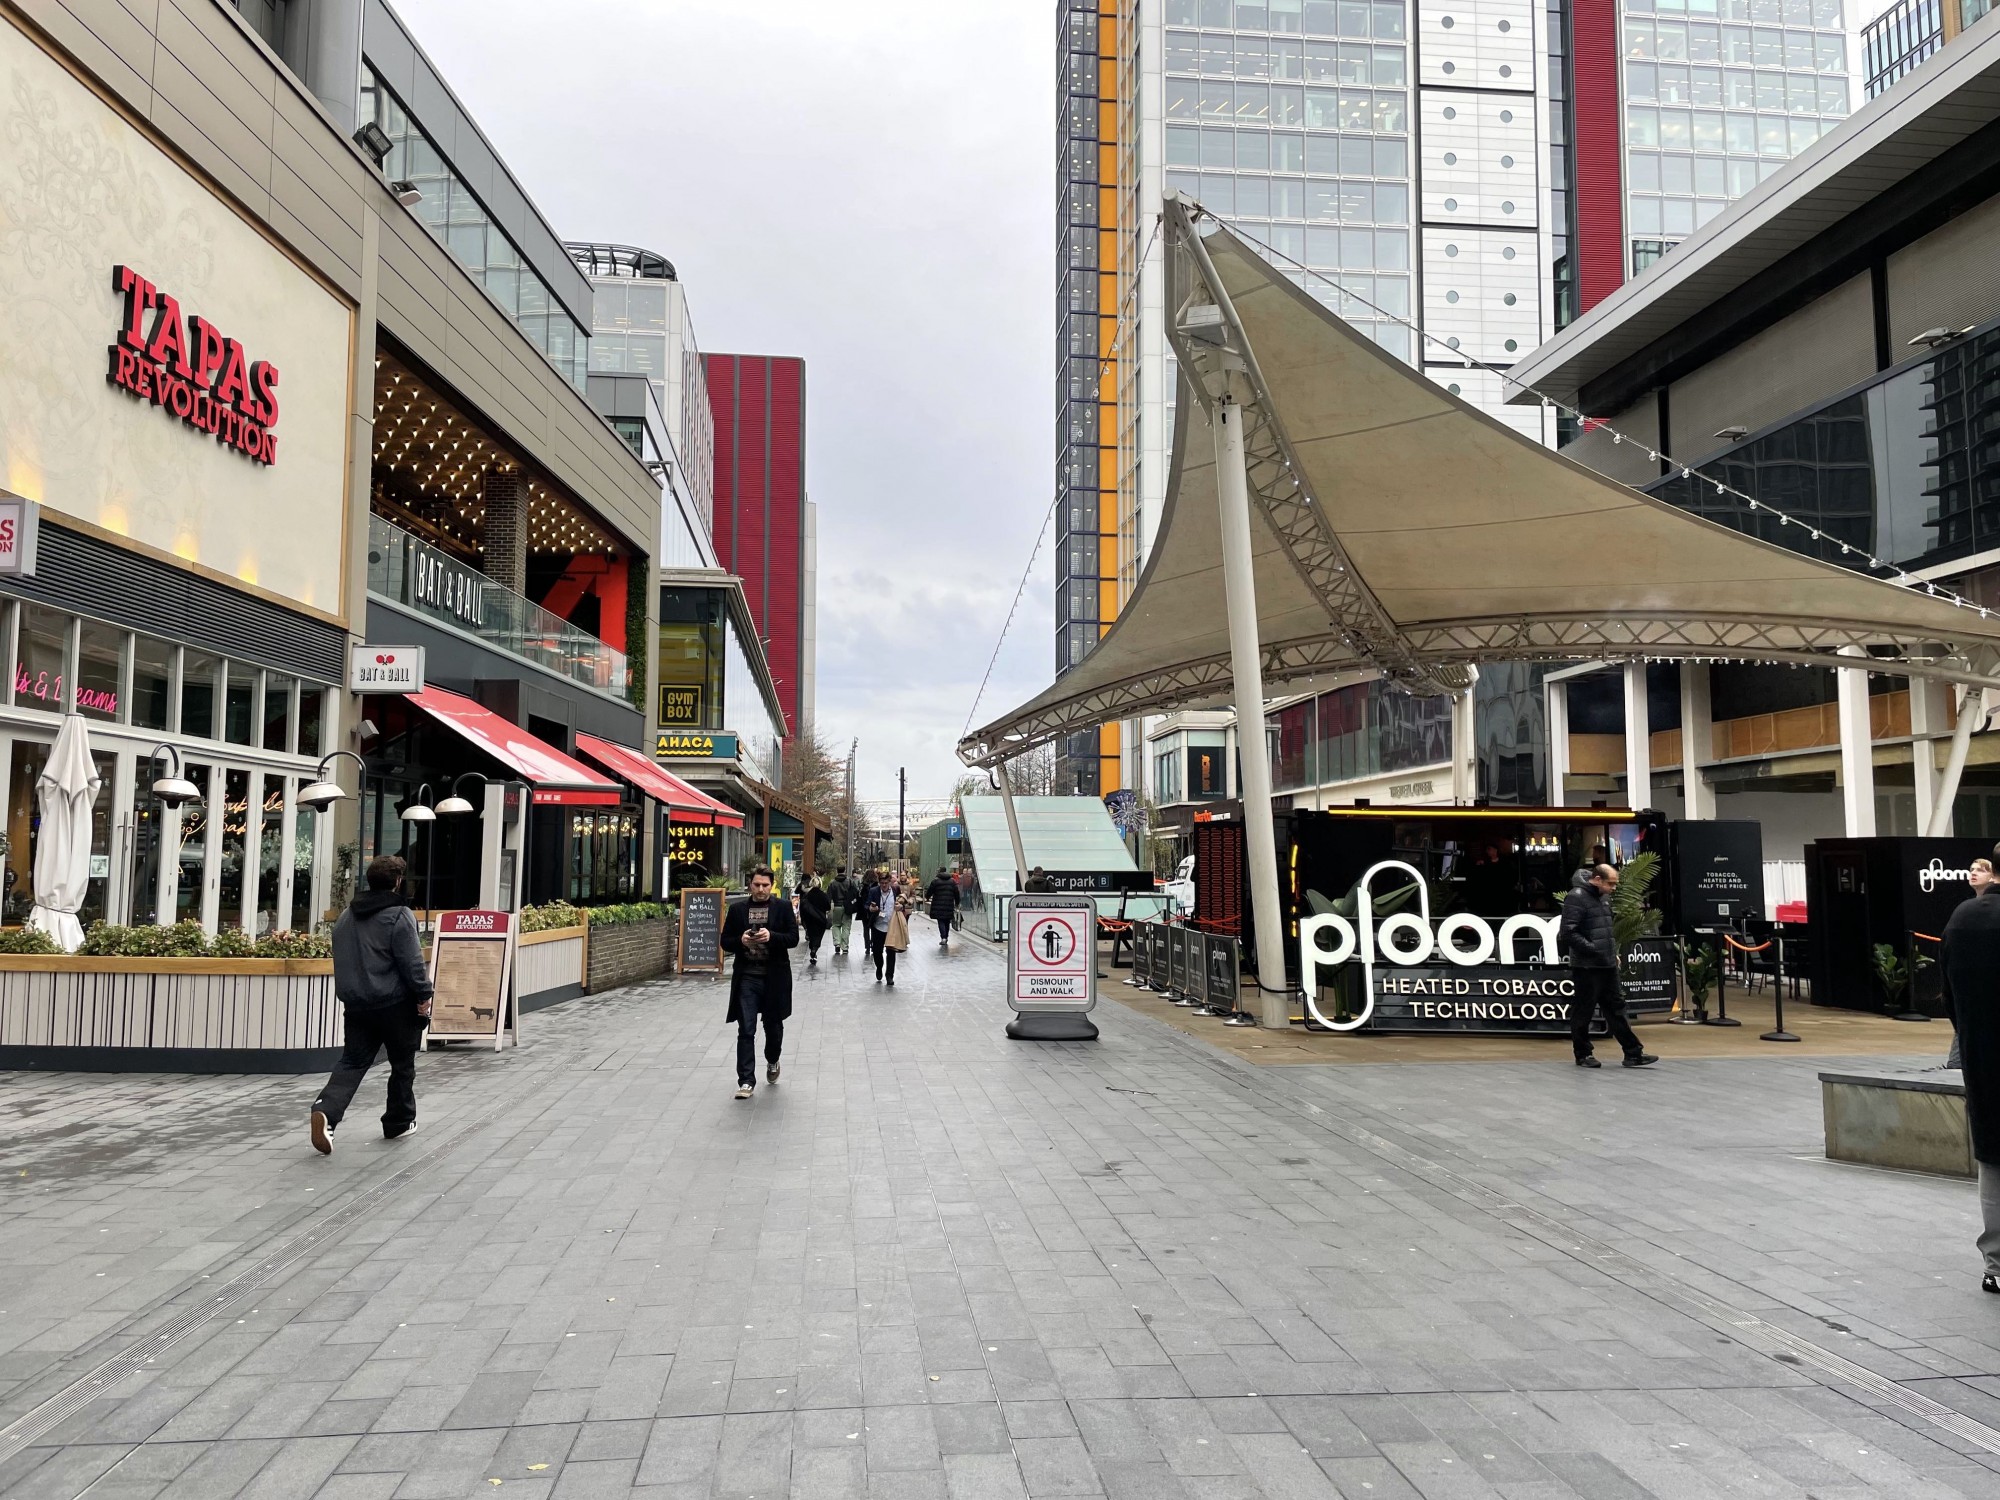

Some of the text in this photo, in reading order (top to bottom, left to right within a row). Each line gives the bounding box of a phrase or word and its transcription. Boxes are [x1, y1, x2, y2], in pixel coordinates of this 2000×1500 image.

[114, 265, 279, 427] TAPAS
[109, 345, 278, 465] REVOLUTION
[417, 552, 483, 627] BAT & BALL
[360, 667, 410, 682] BAT & BALL
[667, 692, 694, 705] GYM
[667, 705, 693, 718] BOX
[657, 736, 713, 747] AHACA
[668, 827, 714, 836] NSHINE
[951, 827, 958, 836] P
[679, 839, 687, 848] &
[669, 851, 703, 860] ACOS
[1919, 858, 1970, 892] ploom
[1046, 875, 1107, 890] Car park B
[456, 915, 494, 924] TAPAS
[1300, 860, 1562, 1031] ploom
[1030, 987, 1074, 995] AND WALK
[1383, 978, 1576, 996] HEATED TOBACC
[1409, 1002, 1570, 1020] TECHNOLOGY
